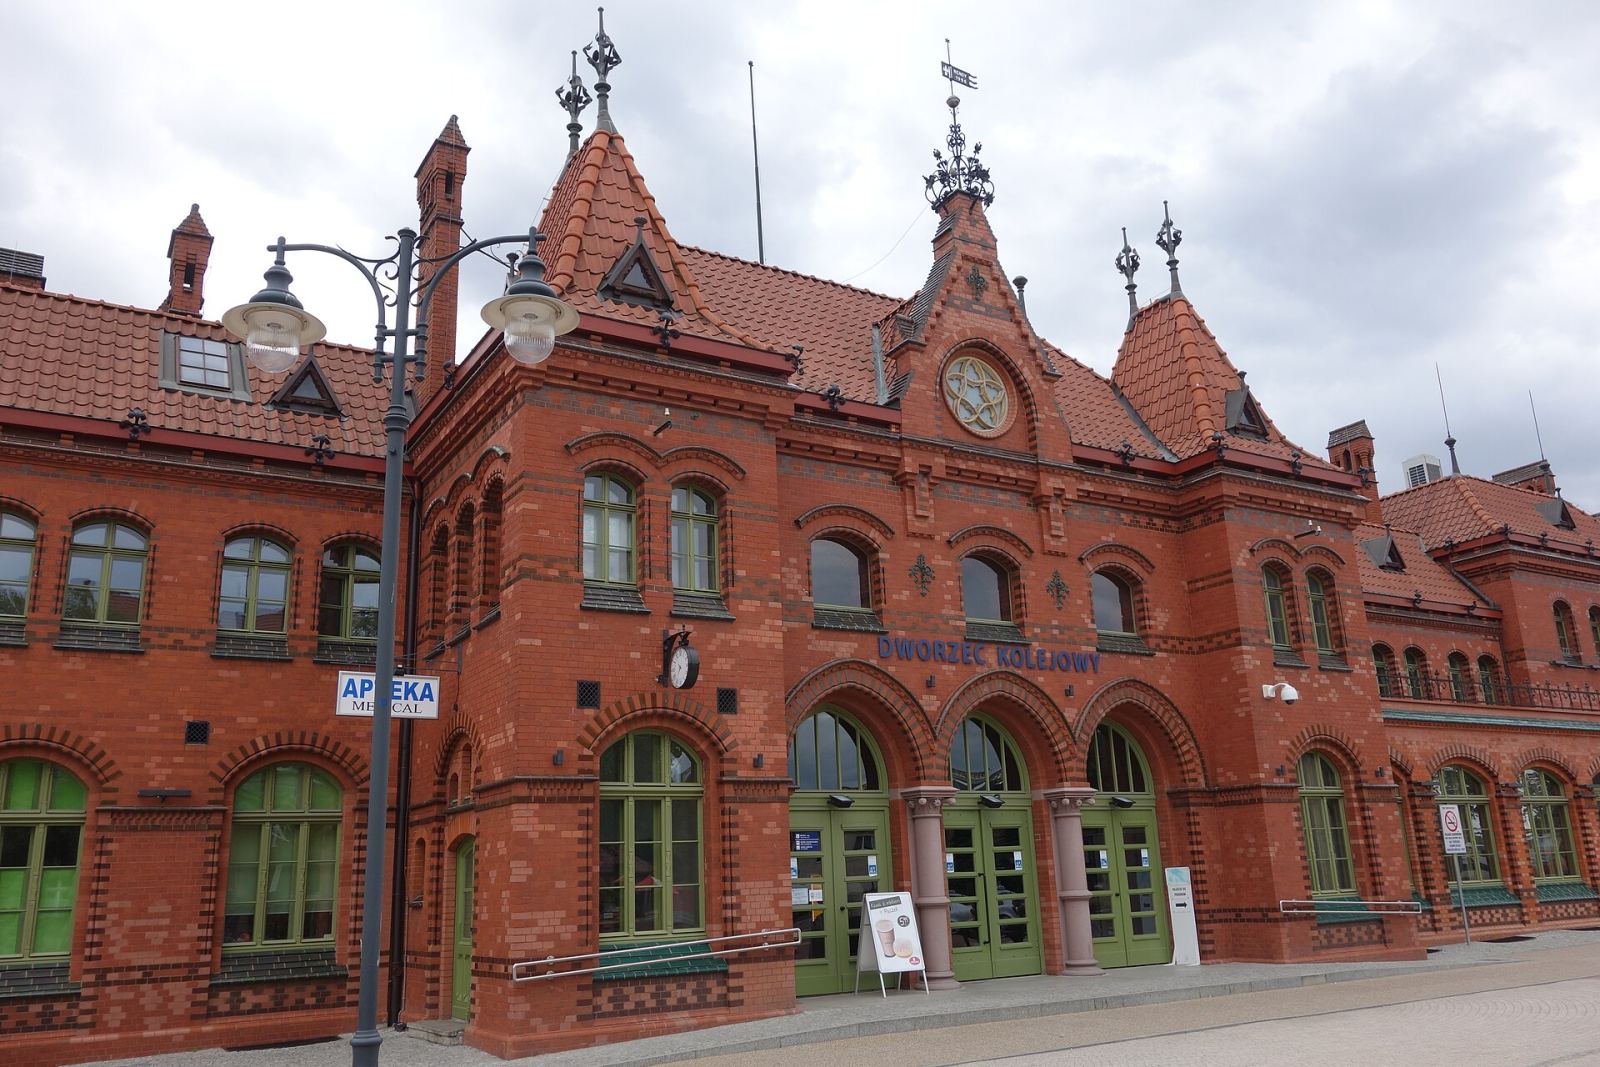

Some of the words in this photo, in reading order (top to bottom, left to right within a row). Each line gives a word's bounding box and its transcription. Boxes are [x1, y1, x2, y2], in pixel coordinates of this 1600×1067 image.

[879, 635, 986, 665] DWORZEC
[996, 644, 1100, 673] KOLEJOWY
[342, 678, 434, 702] APEKA
[352, 701, 422, 714] MECAL
